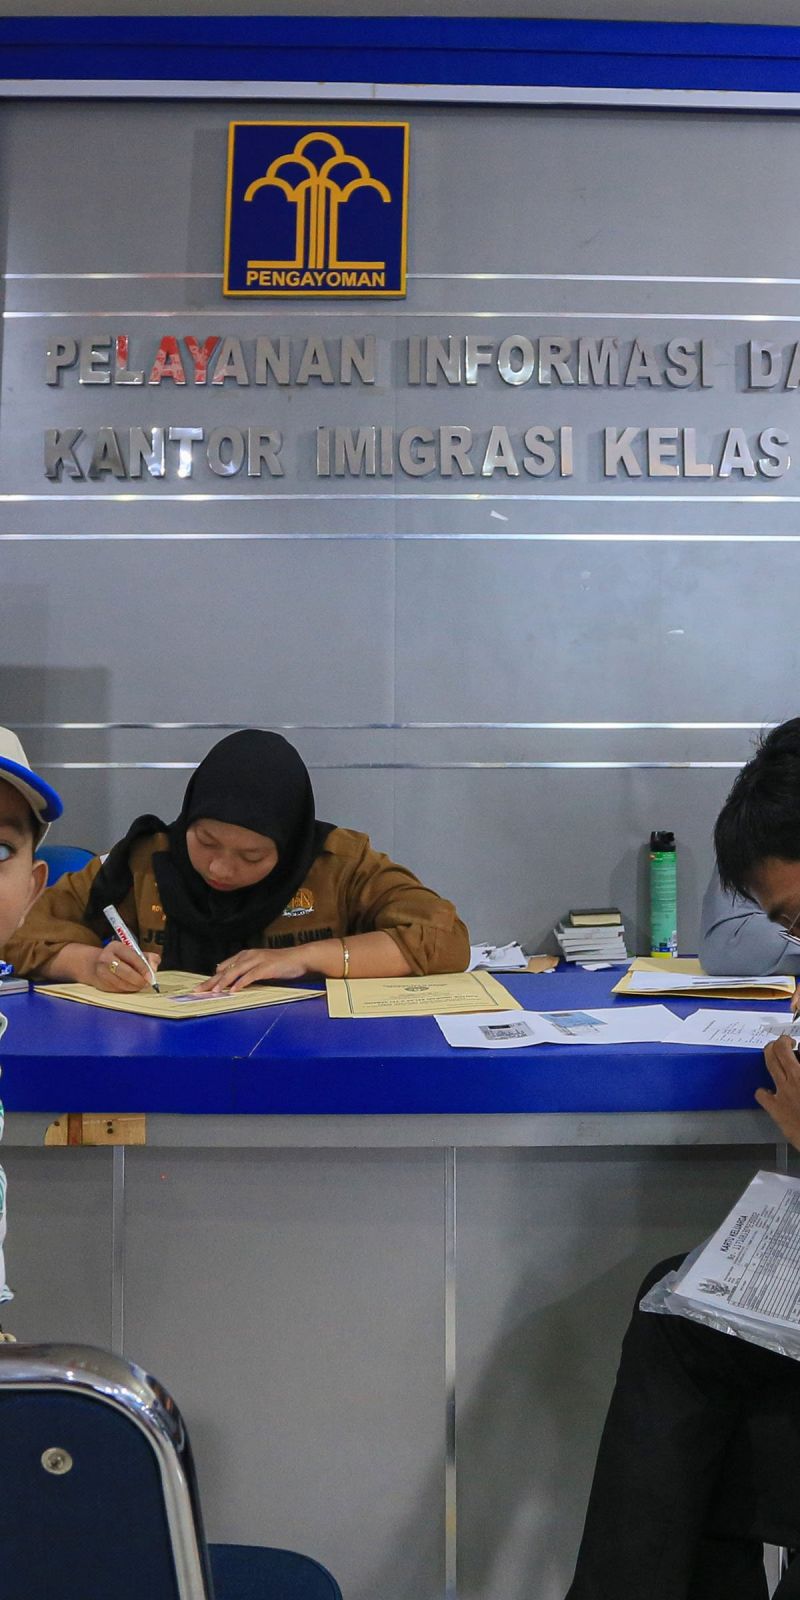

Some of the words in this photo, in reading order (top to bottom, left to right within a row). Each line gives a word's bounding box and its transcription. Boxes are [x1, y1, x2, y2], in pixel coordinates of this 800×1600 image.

[246, 270, 385, 287] PENGAYOMAN
[46, 334, 376, 385] PELAYANAN
[408, 334, 713, 388] INFORMASI
[44, 426, 283, 479] KANTOR
[316, 425, 573, 477] IMIGRASI
[605, 426, 791, 478] KELAS
